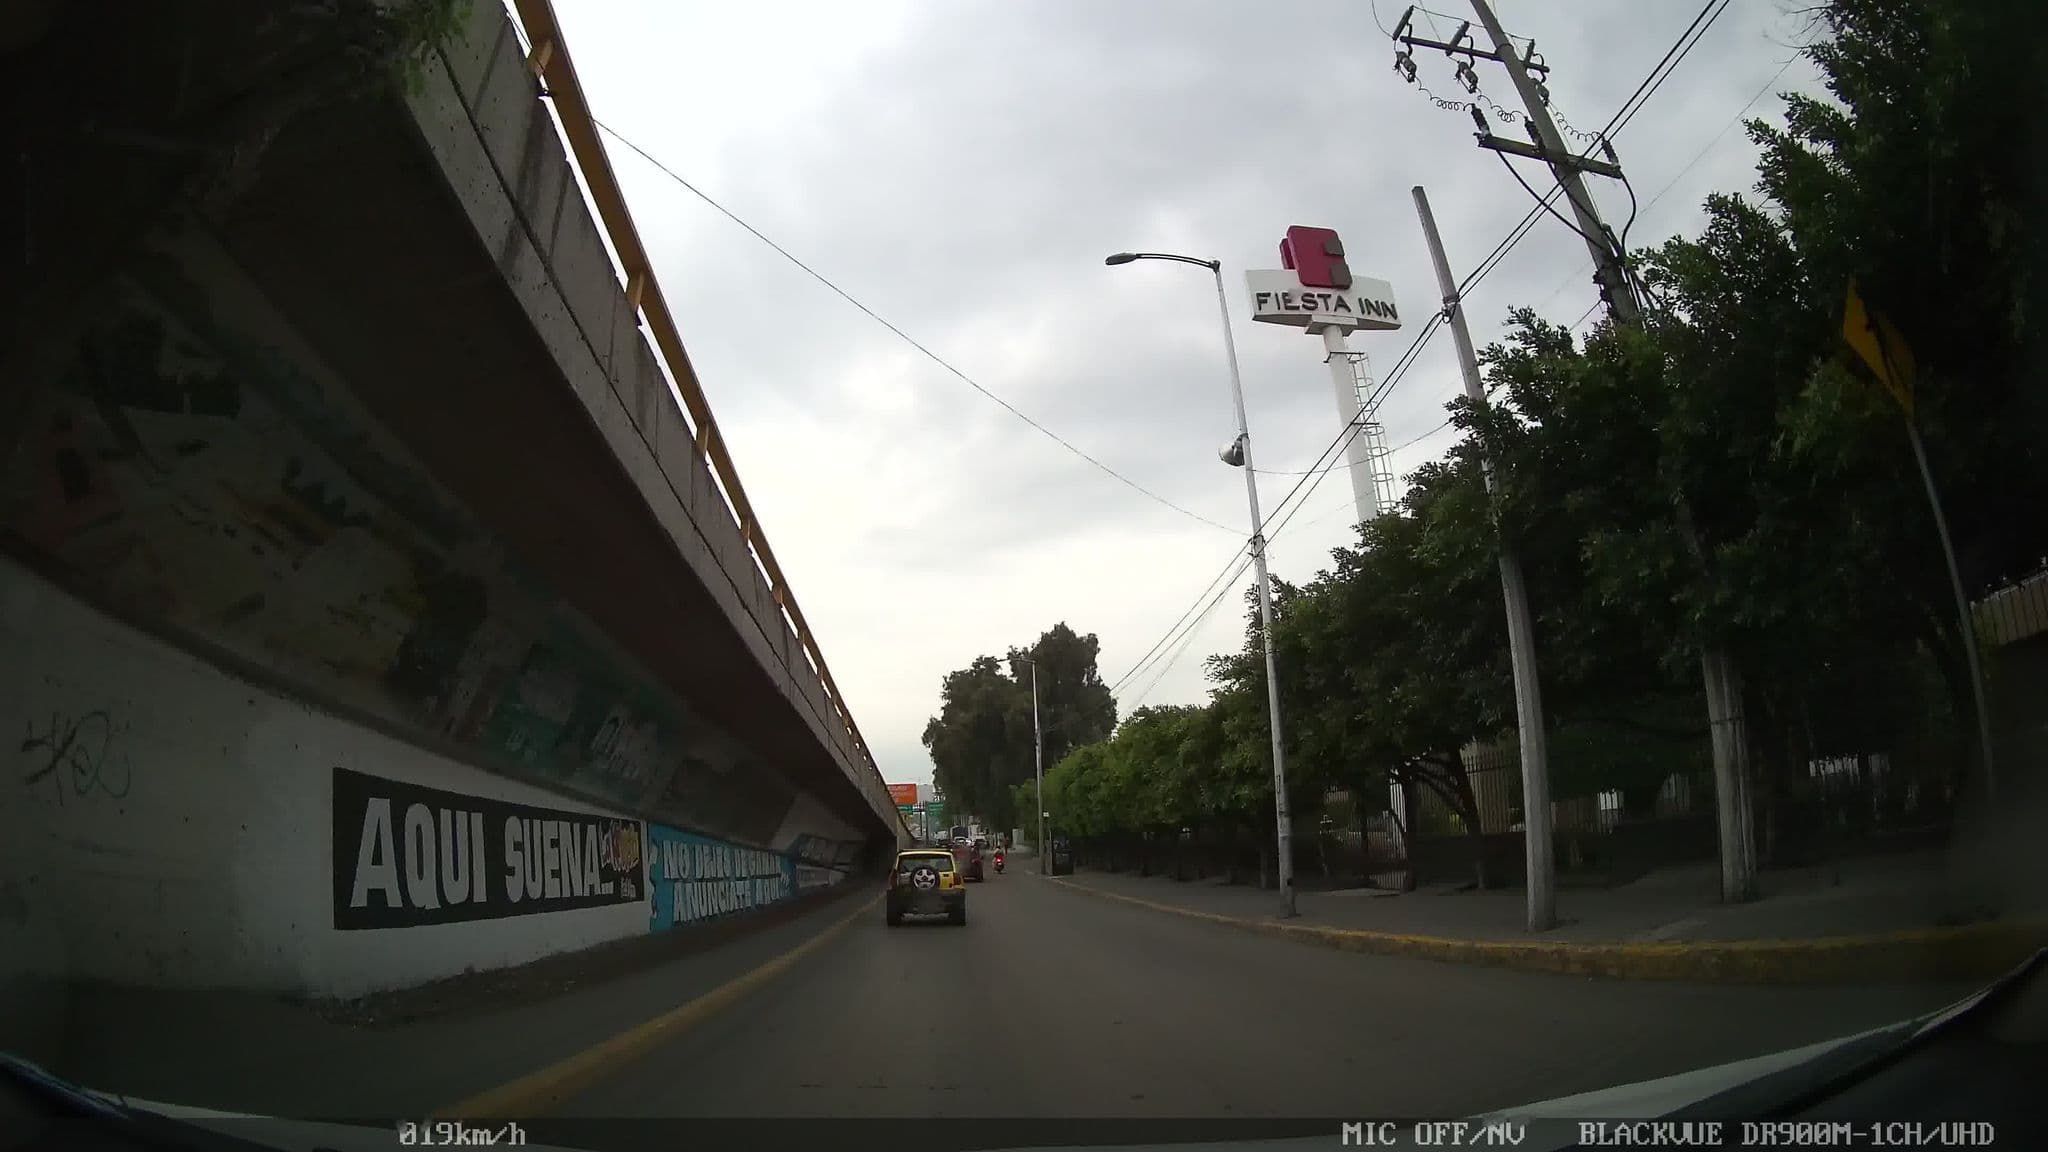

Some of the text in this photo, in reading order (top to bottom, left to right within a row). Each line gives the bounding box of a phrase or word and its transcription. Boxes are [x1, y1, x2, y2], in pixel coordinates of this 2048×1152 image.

[1255, 292, 1398, 321] FIESTA INN
[350, 797, 488, 911] AQUI
[663, 839, 690, 879] NO
[673, 880, 752, 922] ANUNCIATE
